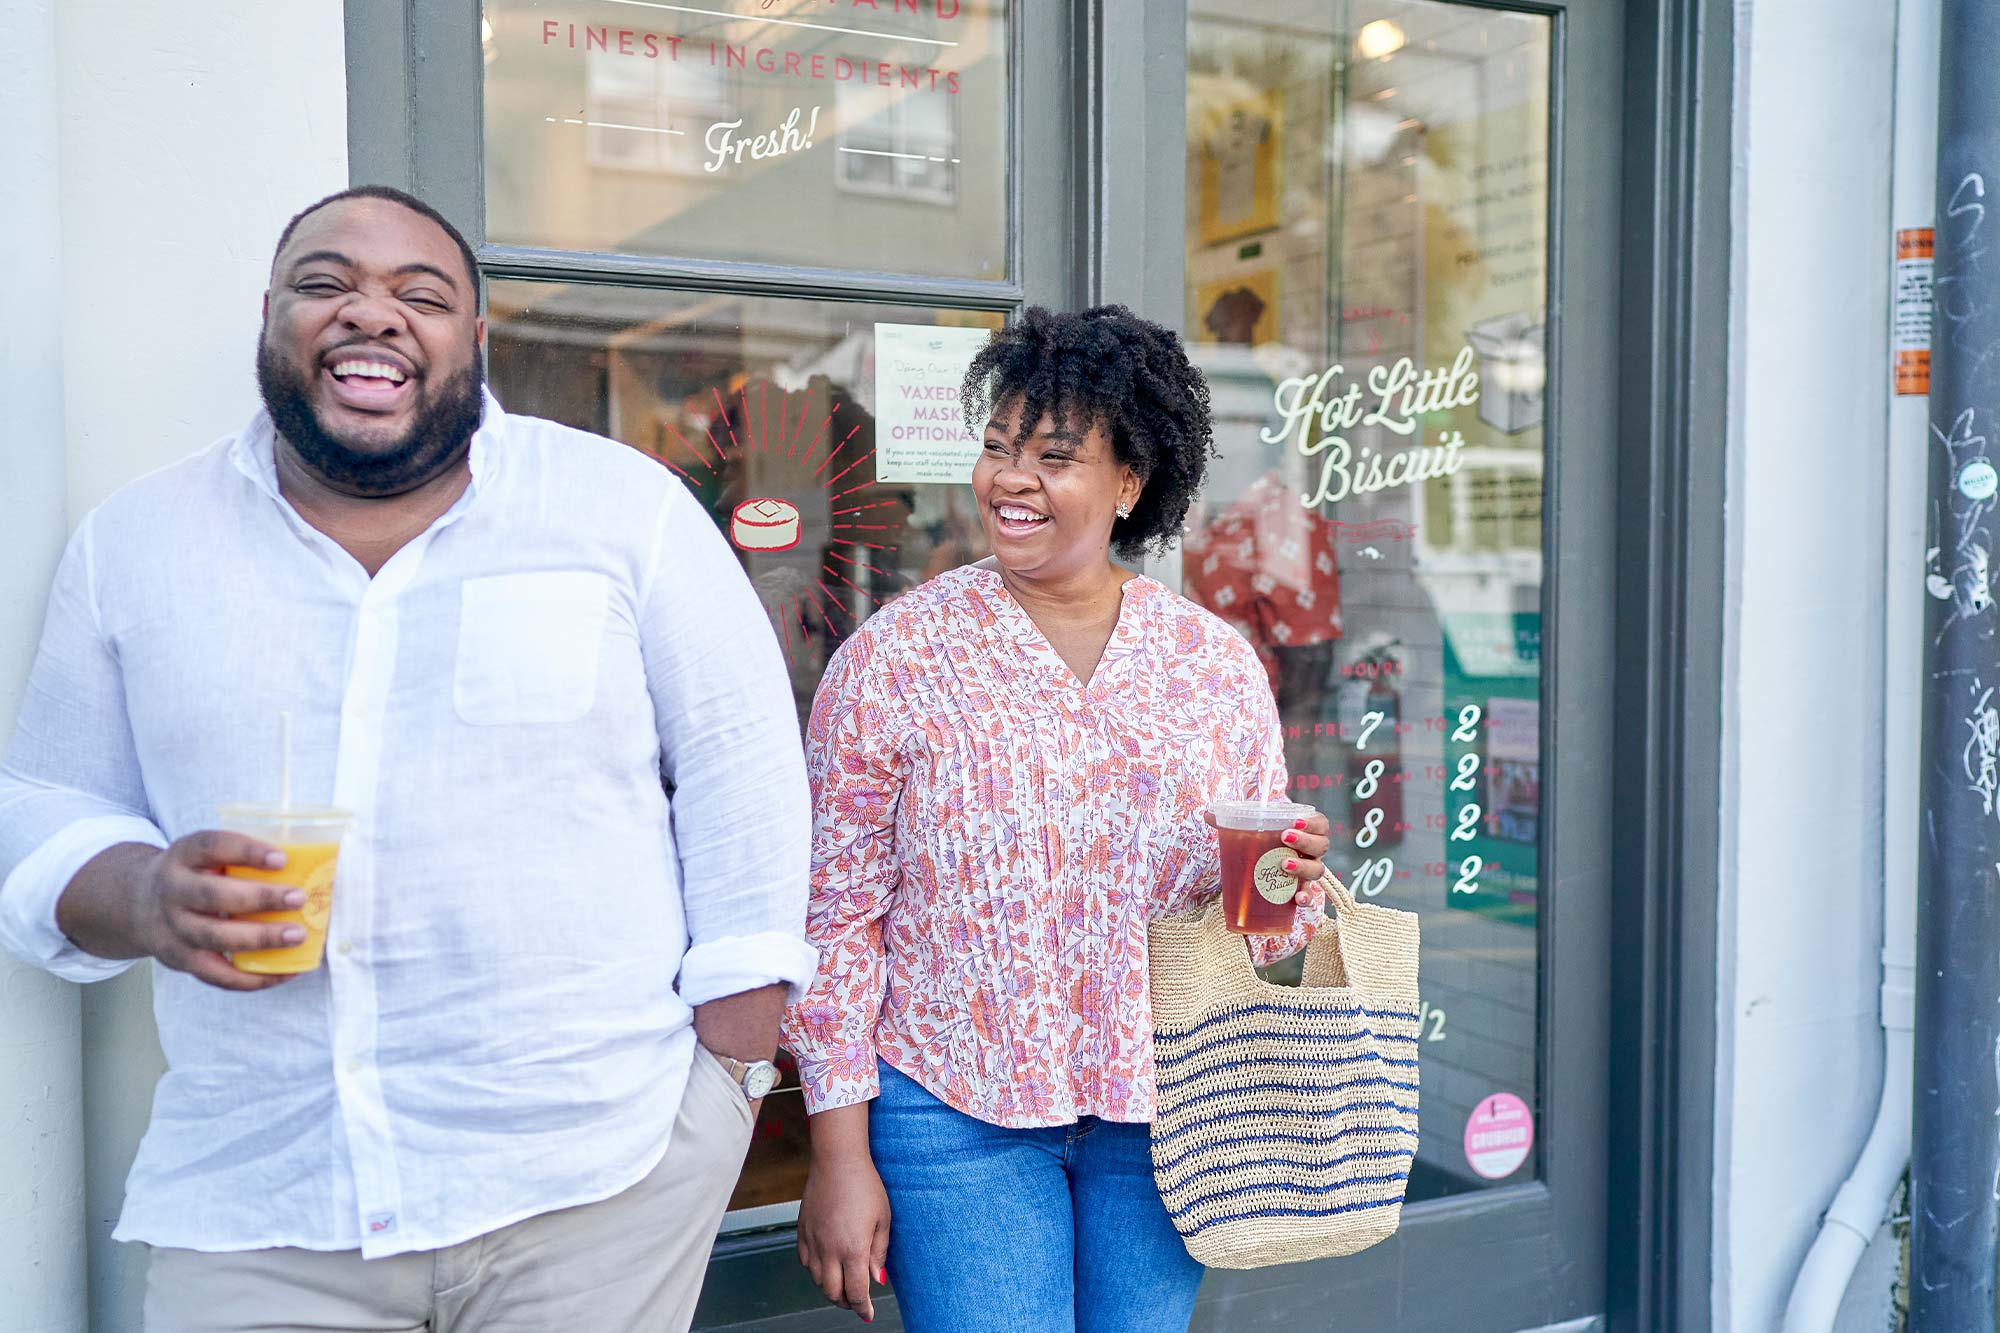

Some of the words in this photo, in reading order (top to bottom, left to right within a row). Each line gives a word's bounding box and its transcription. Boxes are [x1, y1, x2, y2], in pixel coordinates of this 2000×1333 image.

[543, 21, 682, 62] FINEST
[709, 44, 962, 94] INGREDIENTS
[704, 106, 821, 173] Fresh!
[913, 407, 961, 421] MASK
[1260, 364, 1363, 457] Hot
[1364, 345, 1481, 437] Little
[891, 425, 979, 442] OPTIONA
[887, 459, 901, 468] keep
[1300, 430, 1464, 509] Biscuit
[1341, 660, 1403, 678] HOURS
[1356, 711, 1384, 750] 7
[1425, 716, 1447, 731] TO
[1451, 704, 1481, 743] 2
[1355, 759, 1385, 799] 8
[1425, 764, 1447, 780] TO
[1450, 753, 1480, 792] 2
[1355, 807, 1384, 848] 8
[1425, 812, 1446, 829] TO
[1450, 803, 1481, 842] 2
[1258, 866, 1279, 882] Hot
[1351, 857, 1394, 897] 10
[1425, 862, 1446, 877] TO
[1452, 855, 1483, 894] 2
